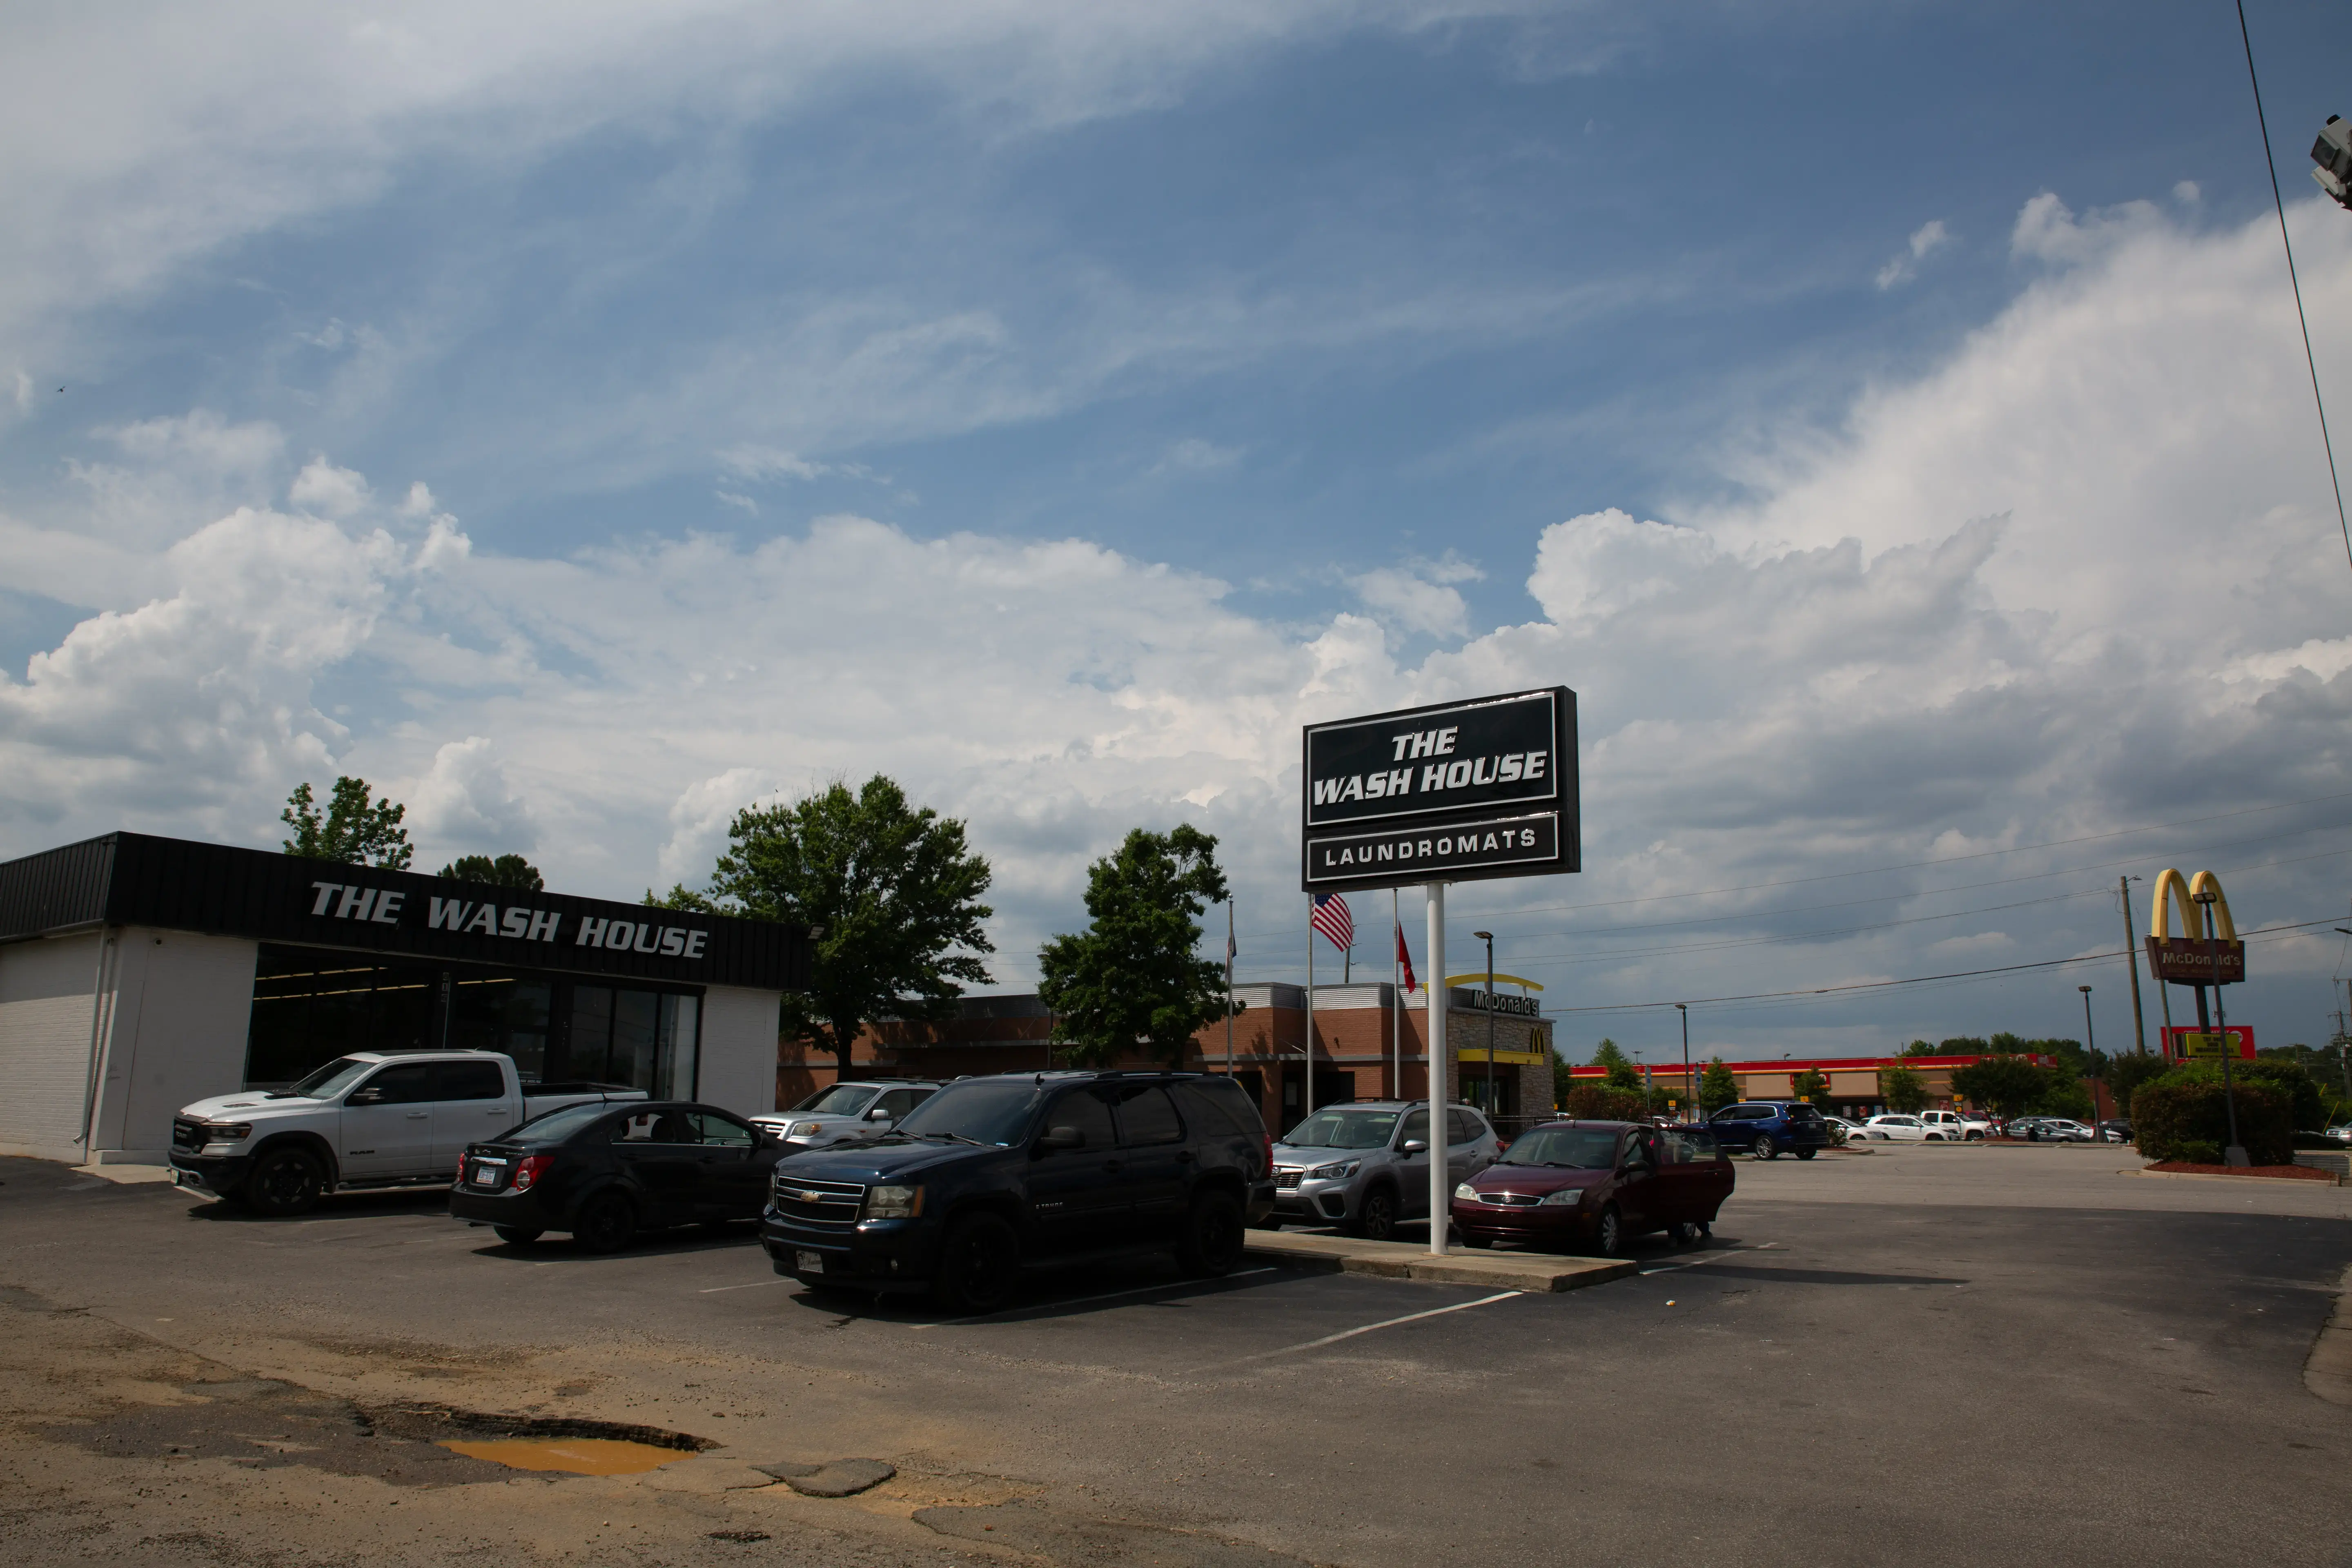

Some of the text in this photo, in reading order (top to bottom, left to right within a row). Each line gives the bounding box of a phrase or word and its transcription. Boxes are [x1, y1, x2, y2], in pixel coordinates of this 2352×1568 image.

[1392, 726, 1458, 761] THE
[1314, 751, 1548, 805] WASH HOUSE
[1325, 829, 1536, 866] LAUNDROMATS
[310, 881, 708, 958] THE WASH HOUSE
[2163, 952, 2241, 966] McDonld's
